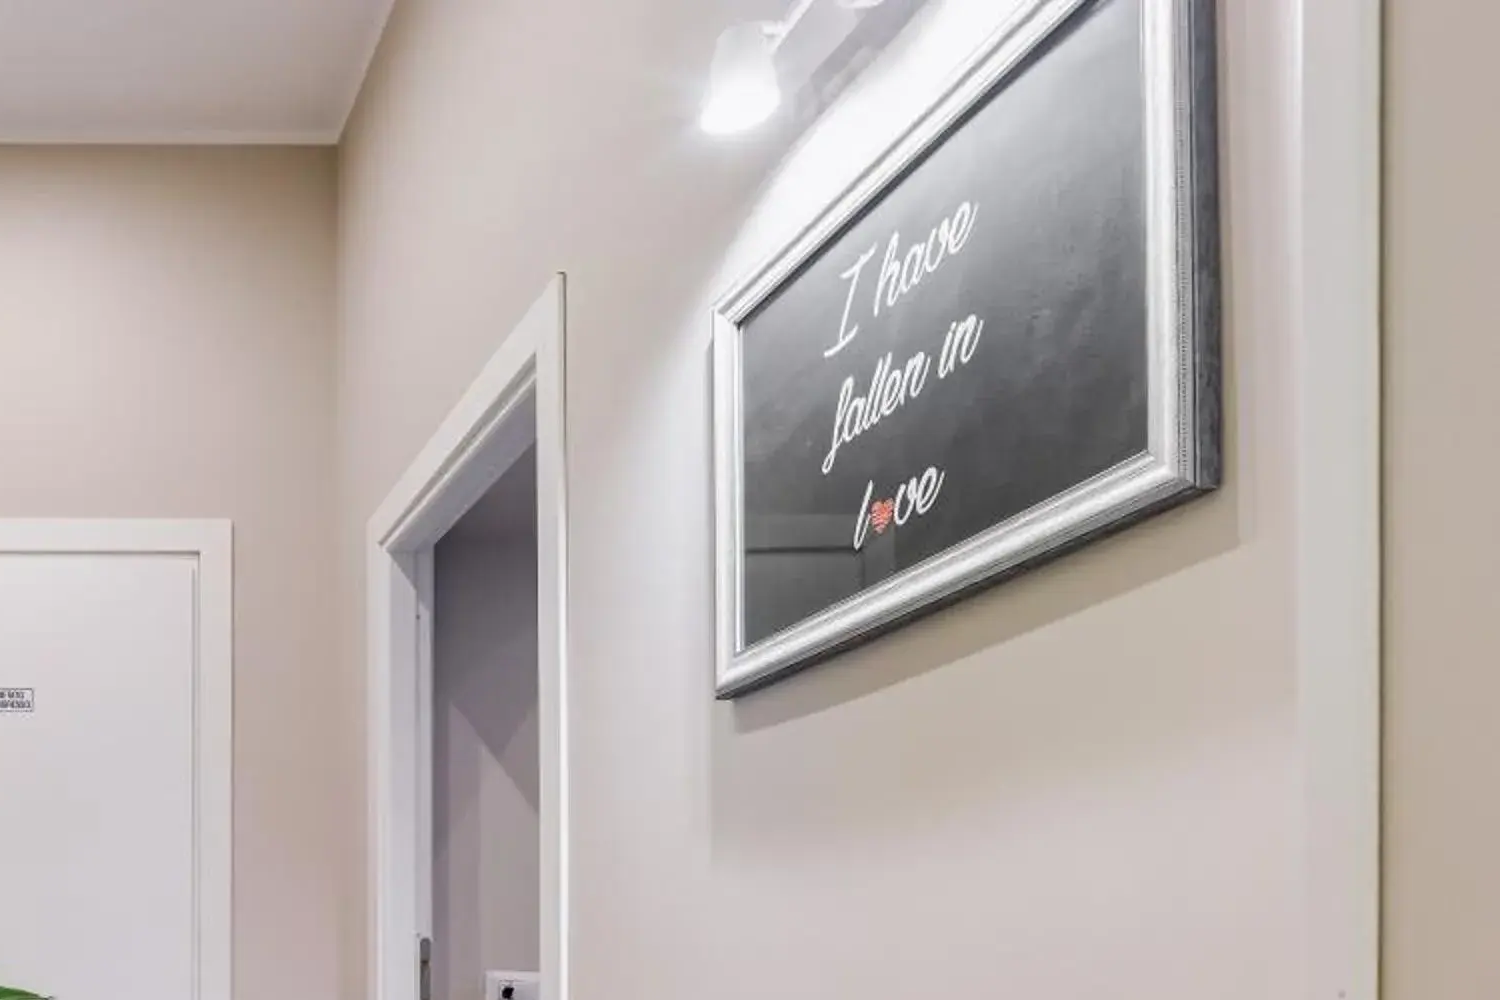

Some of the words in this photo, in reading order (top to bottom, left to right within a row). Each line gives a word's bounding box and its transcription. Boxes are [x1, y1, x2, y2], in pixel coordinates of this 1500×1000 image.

[824, 242, 877, 358] I
[873, 200, 979, 317] have
[821, 350, 931, 474] fallen
[938, 313, 984, 380] in
